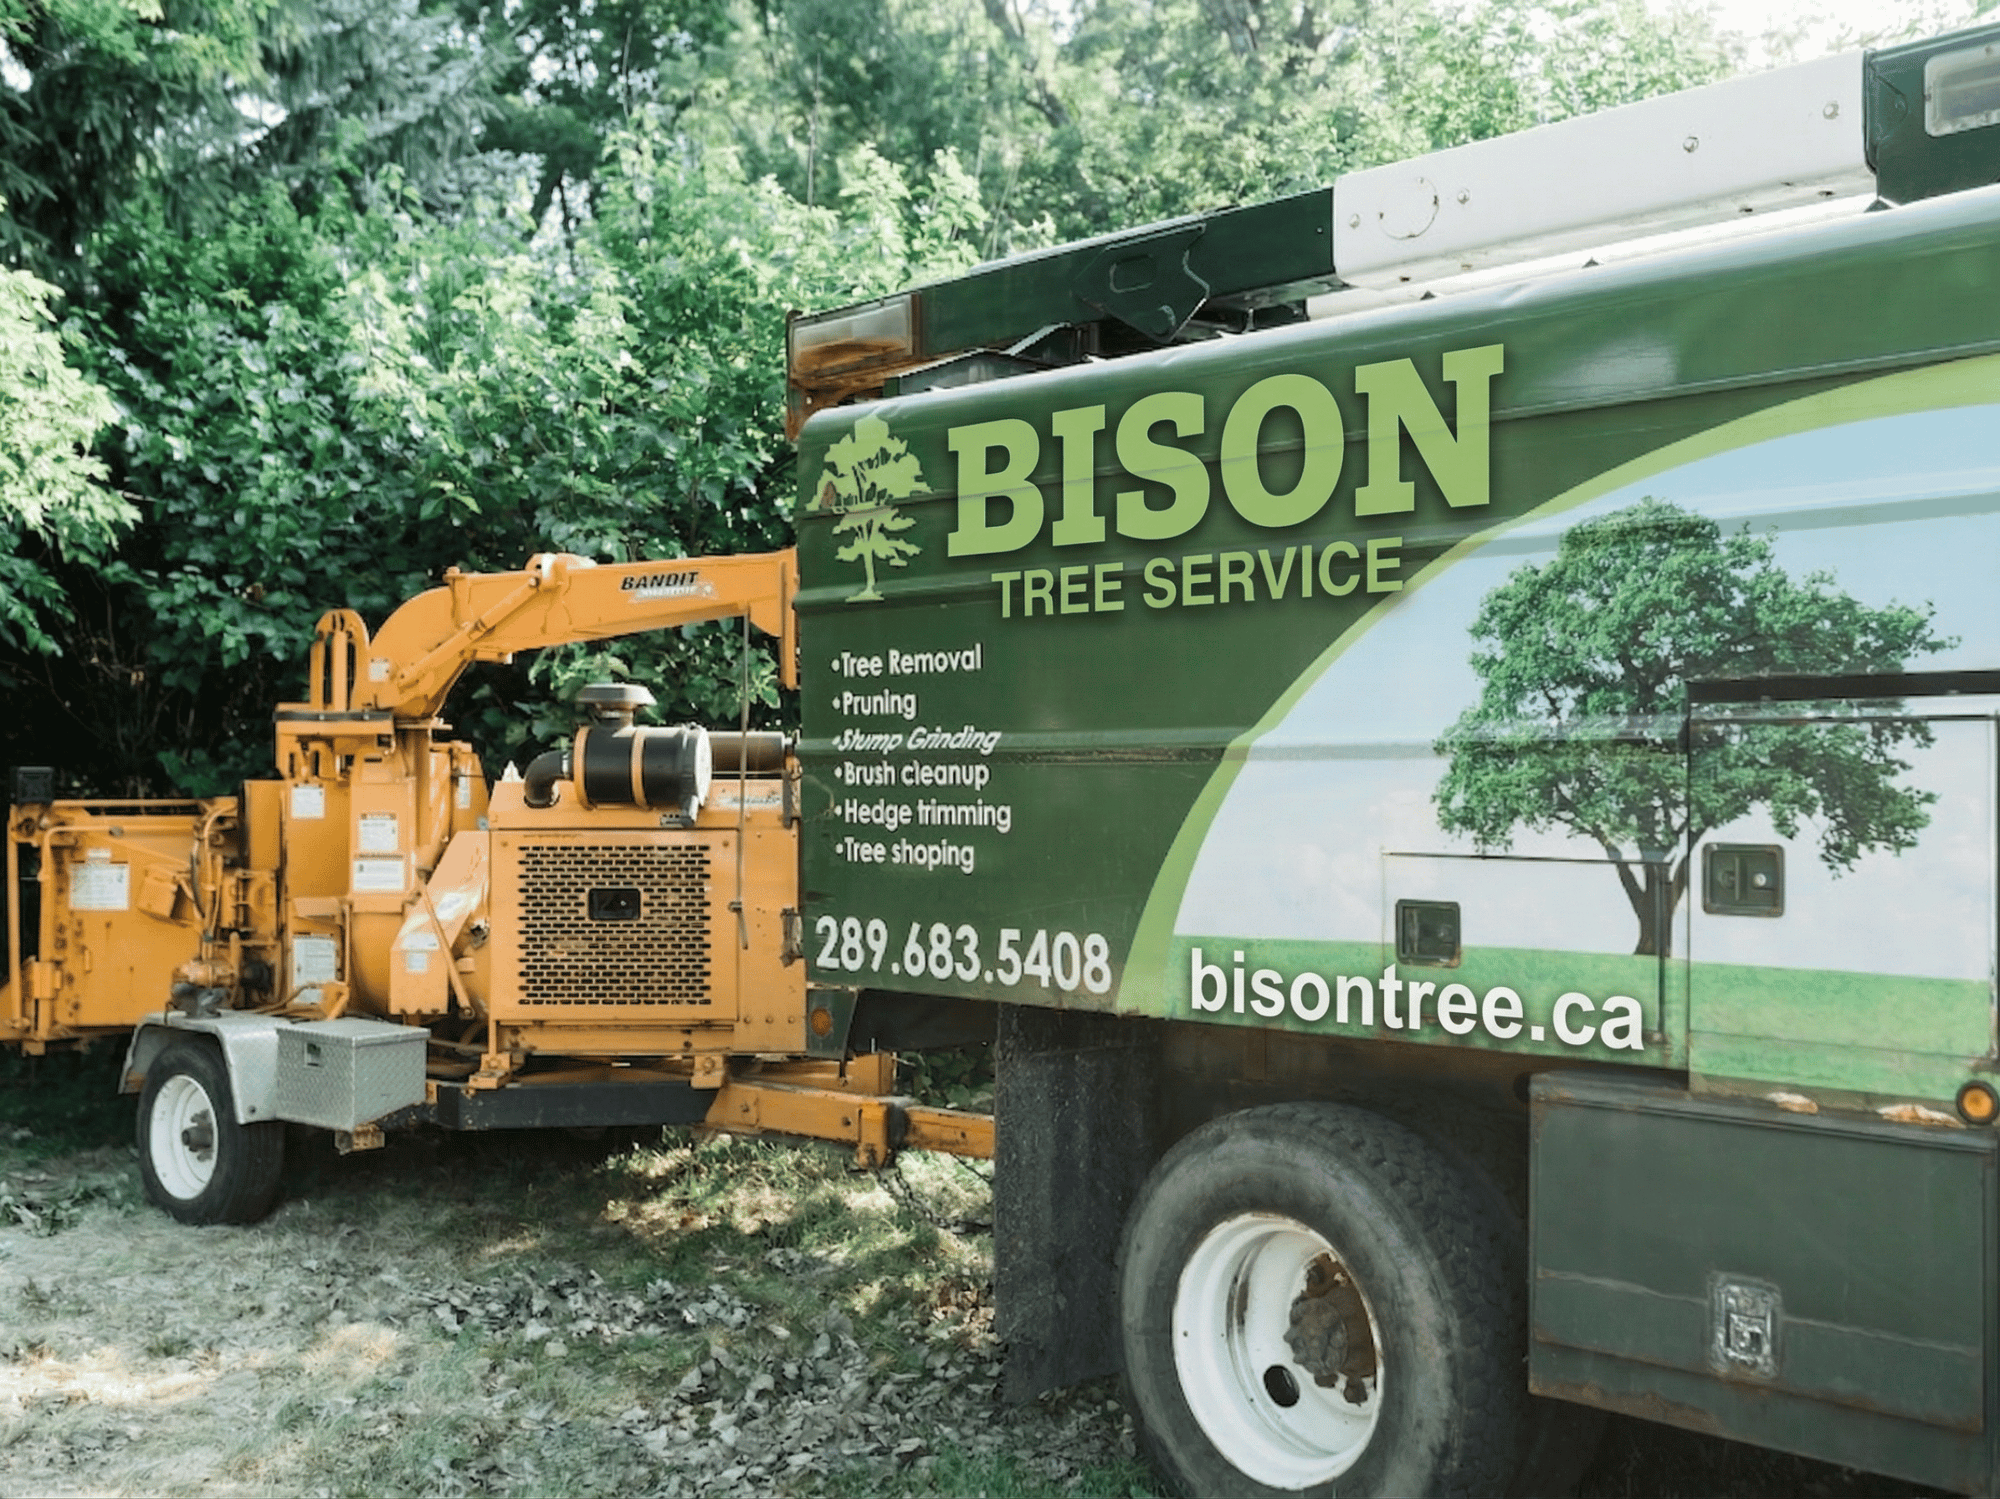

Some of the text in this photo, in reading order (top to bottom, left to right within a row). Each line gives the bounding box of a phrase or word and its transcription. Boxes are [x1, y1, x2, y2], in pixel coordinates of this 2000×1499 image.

[947, 343, 1505, 558] BISON
[621, 571, 699, 591] BANDIT
[991, 537, 1404, 619] TREE SERVICE
[841, 642, 982, 677] Tree Removal
[842, 688, 917, 720] Pruning
[838, 725, 1002, 755] Stump Grinding
[844, 759, 990, 791] Brush cleanup
[844, 798, 1012, 833] Hedge trimming
[844, 836, 974, 875] Tree shoping
[815, 915, 1112, 994] 289.683.5408
[1191, 948, 1645, 1051] bisontree.ca
